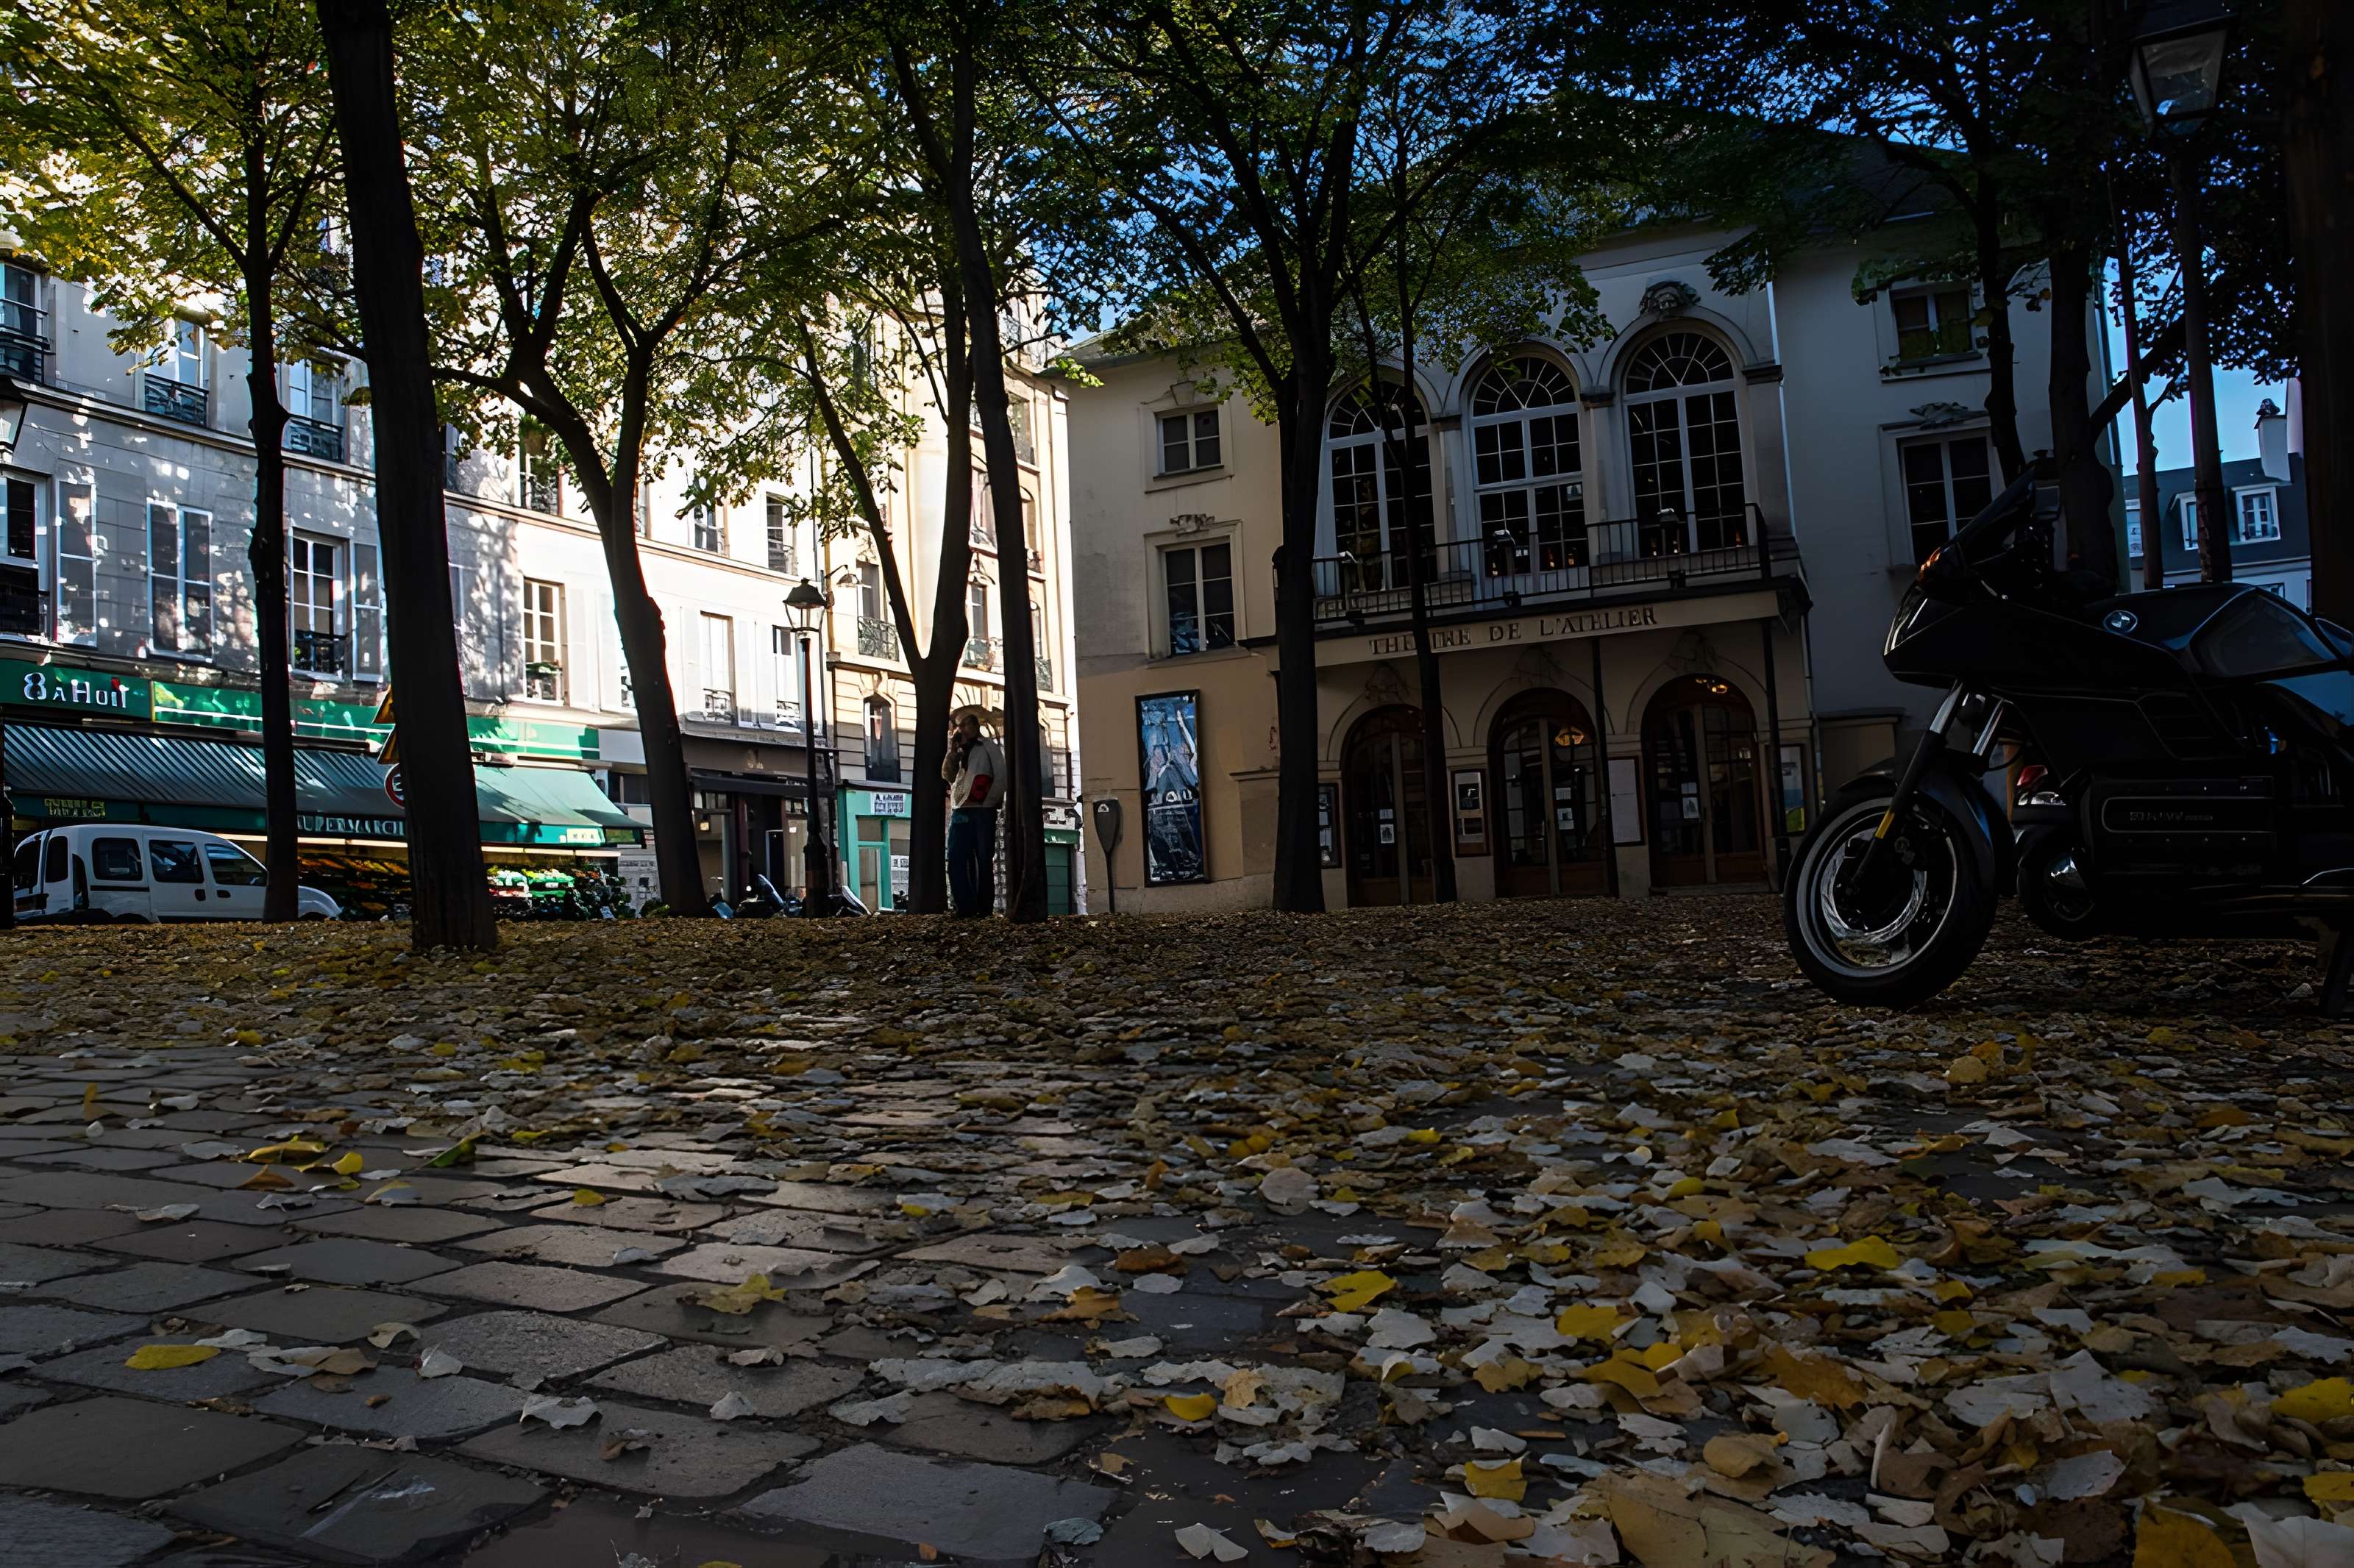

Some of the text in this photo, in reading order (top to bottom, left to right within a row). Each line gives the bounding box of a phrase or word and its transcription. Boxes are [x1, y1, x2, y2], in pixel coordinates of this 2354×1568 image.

[1488, 622, 1521, 641] DE
[1540, 606, 1656, 635] L'ATELIER
[24, 672, 47, 700] 8
